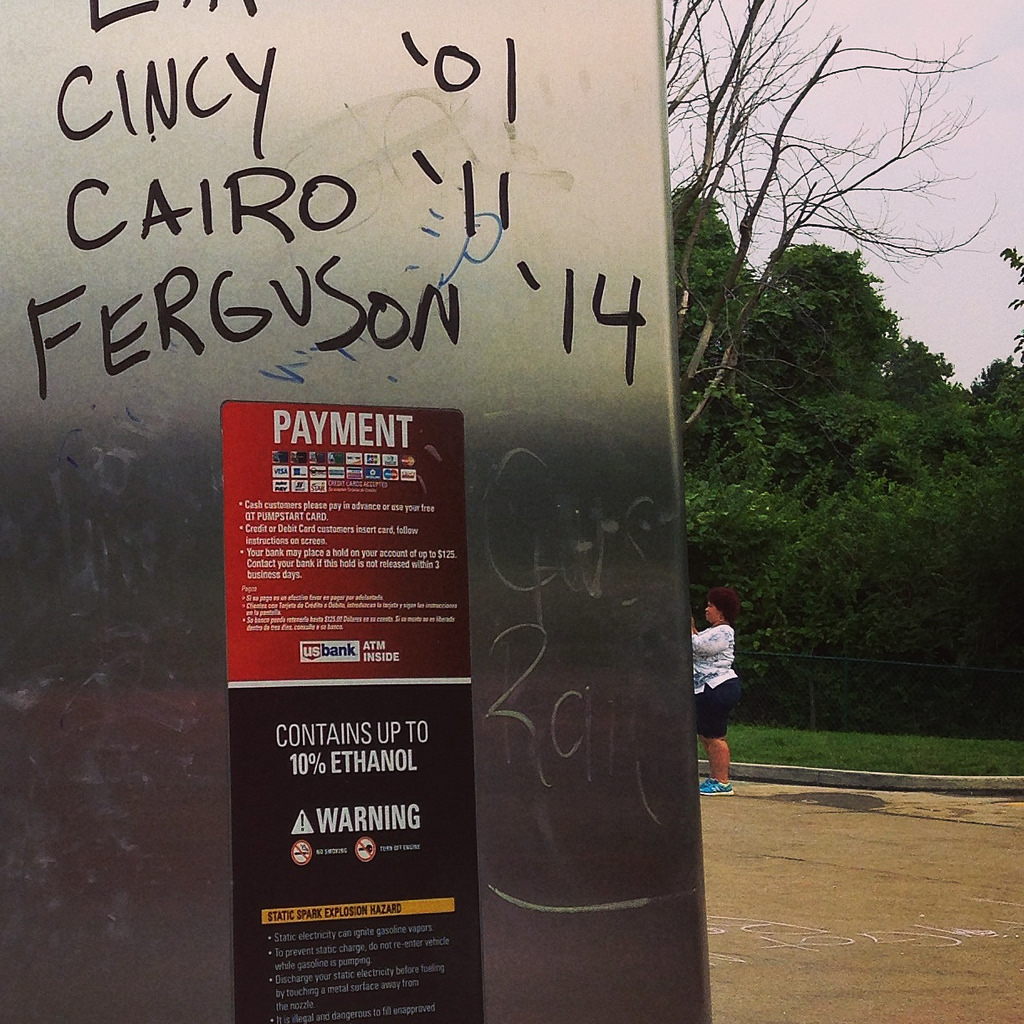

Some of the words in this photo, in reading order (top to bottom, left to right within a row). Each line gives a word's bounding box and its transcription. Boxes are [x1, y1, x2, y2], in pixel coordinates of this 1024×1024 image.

[56, 46, 277, 160] CINCY
[65, 166, 357, 251] CAIRO
[26, 255, 462, 400] FERGUSON
[516, 261, 646, 386] '14
[273, 409, 413, 448] PAYMENT
[245, 500, 263, 509] Cash
[264, 501, 302, 509] customers
[304, 501, 327, 511] please
[329, 503, 342, 511] pay
[343, 501, 350, 509] in
[352, 502, 381, 511] advance
[405, 505, 420, 513] your
[421, 503, 435, 512] free
[257, 512, 304, 521] PUMPSTART
[306, 512, 329, 521] CARD.
[245, 524, 267, 533] Credit
[278, 524, 297, 533] Debit
[299, 524, 316, 533] Card
[317, 525, 354, 534] customers
[356, 525, 376, 534] insert
[378, 525, 396, 535] card,
[397, 526, 419, 534] follow
[246, 536, 289, 545] instructions
[247, 547, 264, 557] Your
[265, 548, 284, 556] bank
[286, 550, 302, 558] may
[304, 548, 324, 558] place
[333, 548, 349, 557] hold
[362, 550, 378, 559] your
[379, 549, 408, 557] account
[410, 549, 417, 558] of
[419, 551, 427, 560] up
[429, 550, 436, 558] to
[438, 549, 457, 559] $125.
[247, 559, 276, 568] Contact
[277, 561, 294, 569] your
[296, 559, 315, 568] bank
[317, 559, 322, 568] if
[324, 559, 338, 568] this
[339, 559, 356, 568] hold
[358, 560, 364, 568] is
[366, 560, 378, 568] not
[379, 560, 410, 569] released
[411, 560, 434, 569] within
[435, 561, 440, 569] 3
[247, 570, 281, 579] business
[282, 570, 303, 580] days.
[363, 641, 385, 650] ATM
[363, 652, 400, 662] INSIDE
[276, 722, 372, 747] CONTAINS
[377, 721, 401, 745] UP
[405, 720, 429, 743] TO
[289, 752, 326, 775] 10%
[331, 749, 417, 774] ETHANOL
[316, 804, 421, 833] WARNING
[267, 910, 294, 922] STATIC
[297, 908, 322, 920] SPARK
[324, 905, 368, 918] EXPLOSION
[370, 903, 402, 915] HAZARD
[274, 932, 296, 943] Static
[298, 930, 336, 941] electricity
[338, 929, 352, 938] can
[353, 927, 374, 938] ignite
[376, 925, 407, 937] gasoline
[275, 947, 284, 957] To
[285, 946, 314, 958] prevent
[316, 944, 336, 954] static
[369, 942, 378, 951] do
[380, 941, 392, 950] not
[394, 939, 423, 949] re-enter
[425, 936, 450, 946] vehicle
[275, 960, 296, 971] while
[297, 959, 328, 971] gasoline
[330, 959, 337, 967] is
[276, 973, 313, 985] Discharge
[315, 972, 331, 983] your
[333, 970, 355, 980] static
[357, 967, 394, 978] electricity
[396, 965, 419, 975] before
[421, 964, 445, 974] fueling
[276, 989, 285, 999] by
[286, 986, 319, 997] touching
[328, 984, 349, 993] metal
[350, 982, 379, 992] surface
[381, 981, 401, 990] away
[402, 979, 419, 988] from
[276, 1001, 288, 1011] the
[276, 1015, 282, 1024] It
[284, 1016, 290, 1024] is
[292, 1013, 314, 1024] illegal
[316, 1012, 330, 1021] and
[332, 1009, 372, 1021] dangerous
[373, 1008, 381, 1017] to
[382, 1006, 392, 1016] fill
[393, 1003, 436, 1015] unapproved
